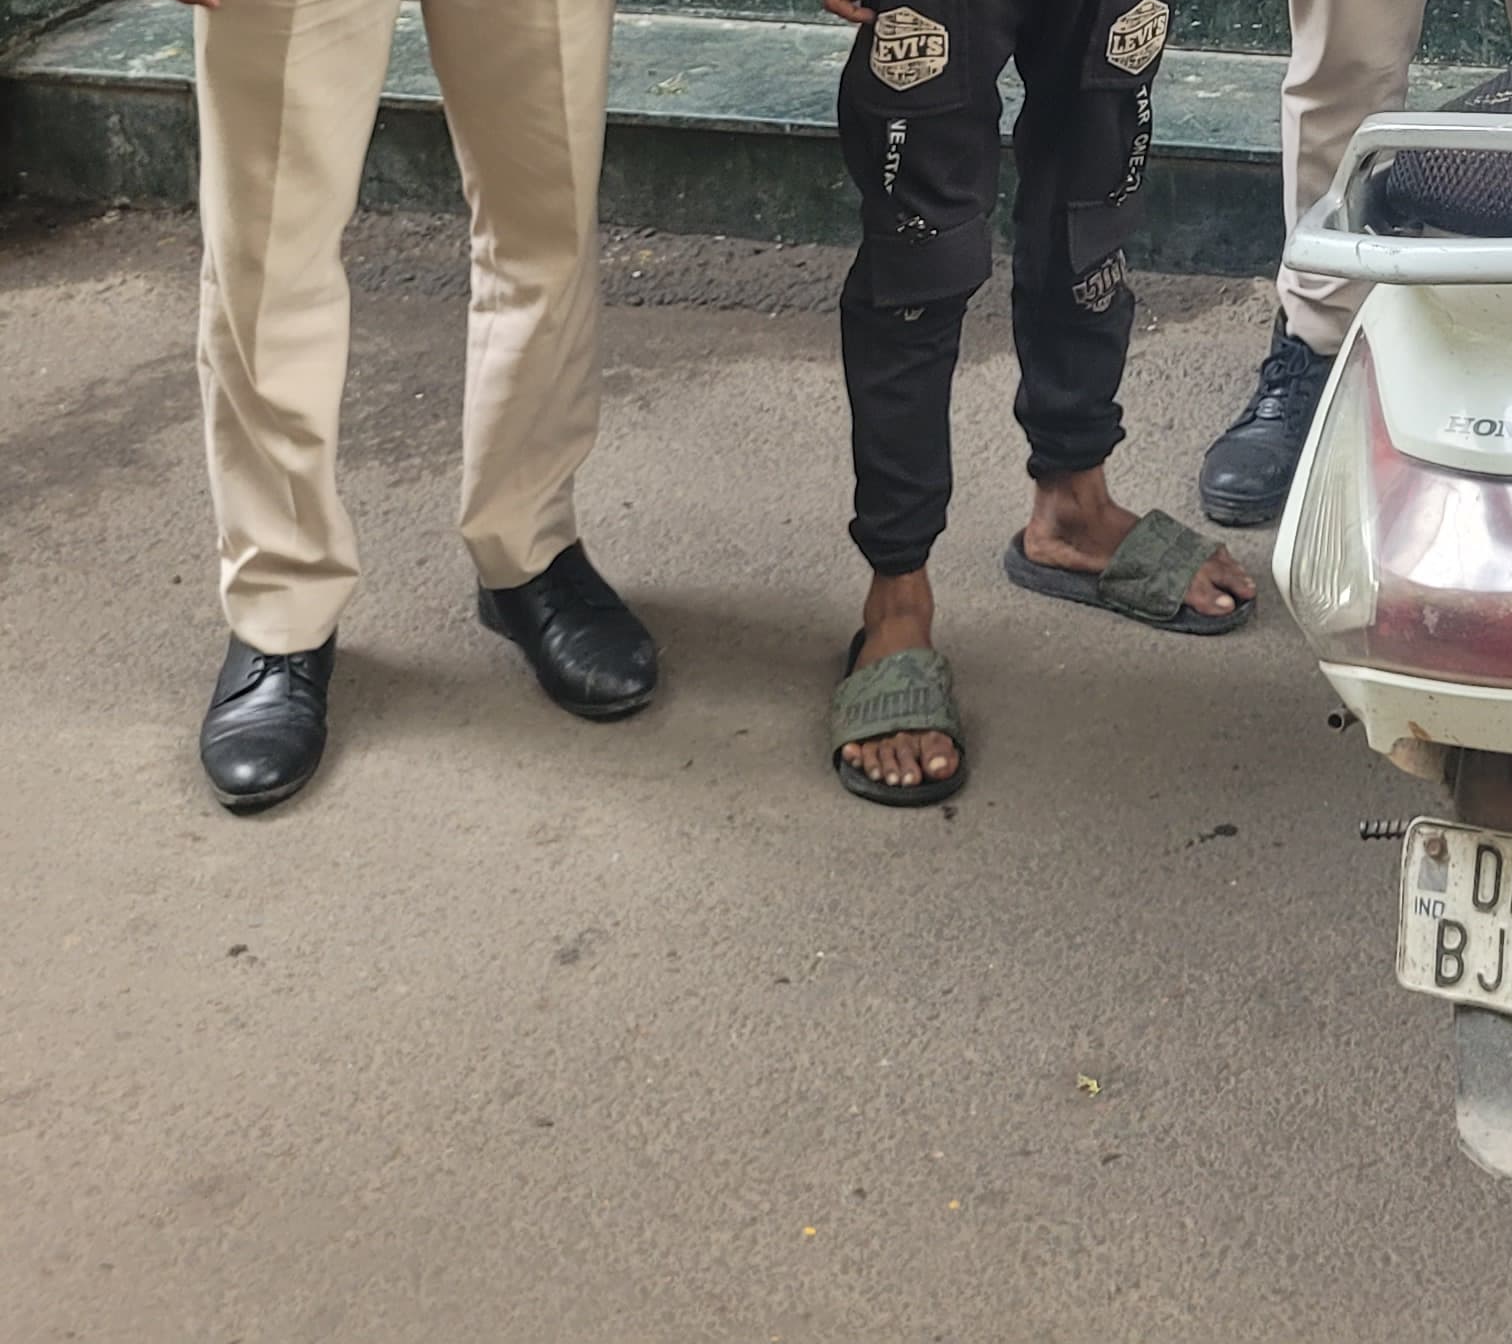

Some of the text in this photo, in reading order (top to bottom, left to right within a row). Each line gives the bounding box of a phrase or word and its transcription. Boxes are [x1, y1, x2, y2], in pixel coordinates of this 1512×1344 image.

[874, 34, 946, 62] EVI'S
[1111, 14, 1167, 56] LEVI'S
[1413, 895, 1446, 920] IND
